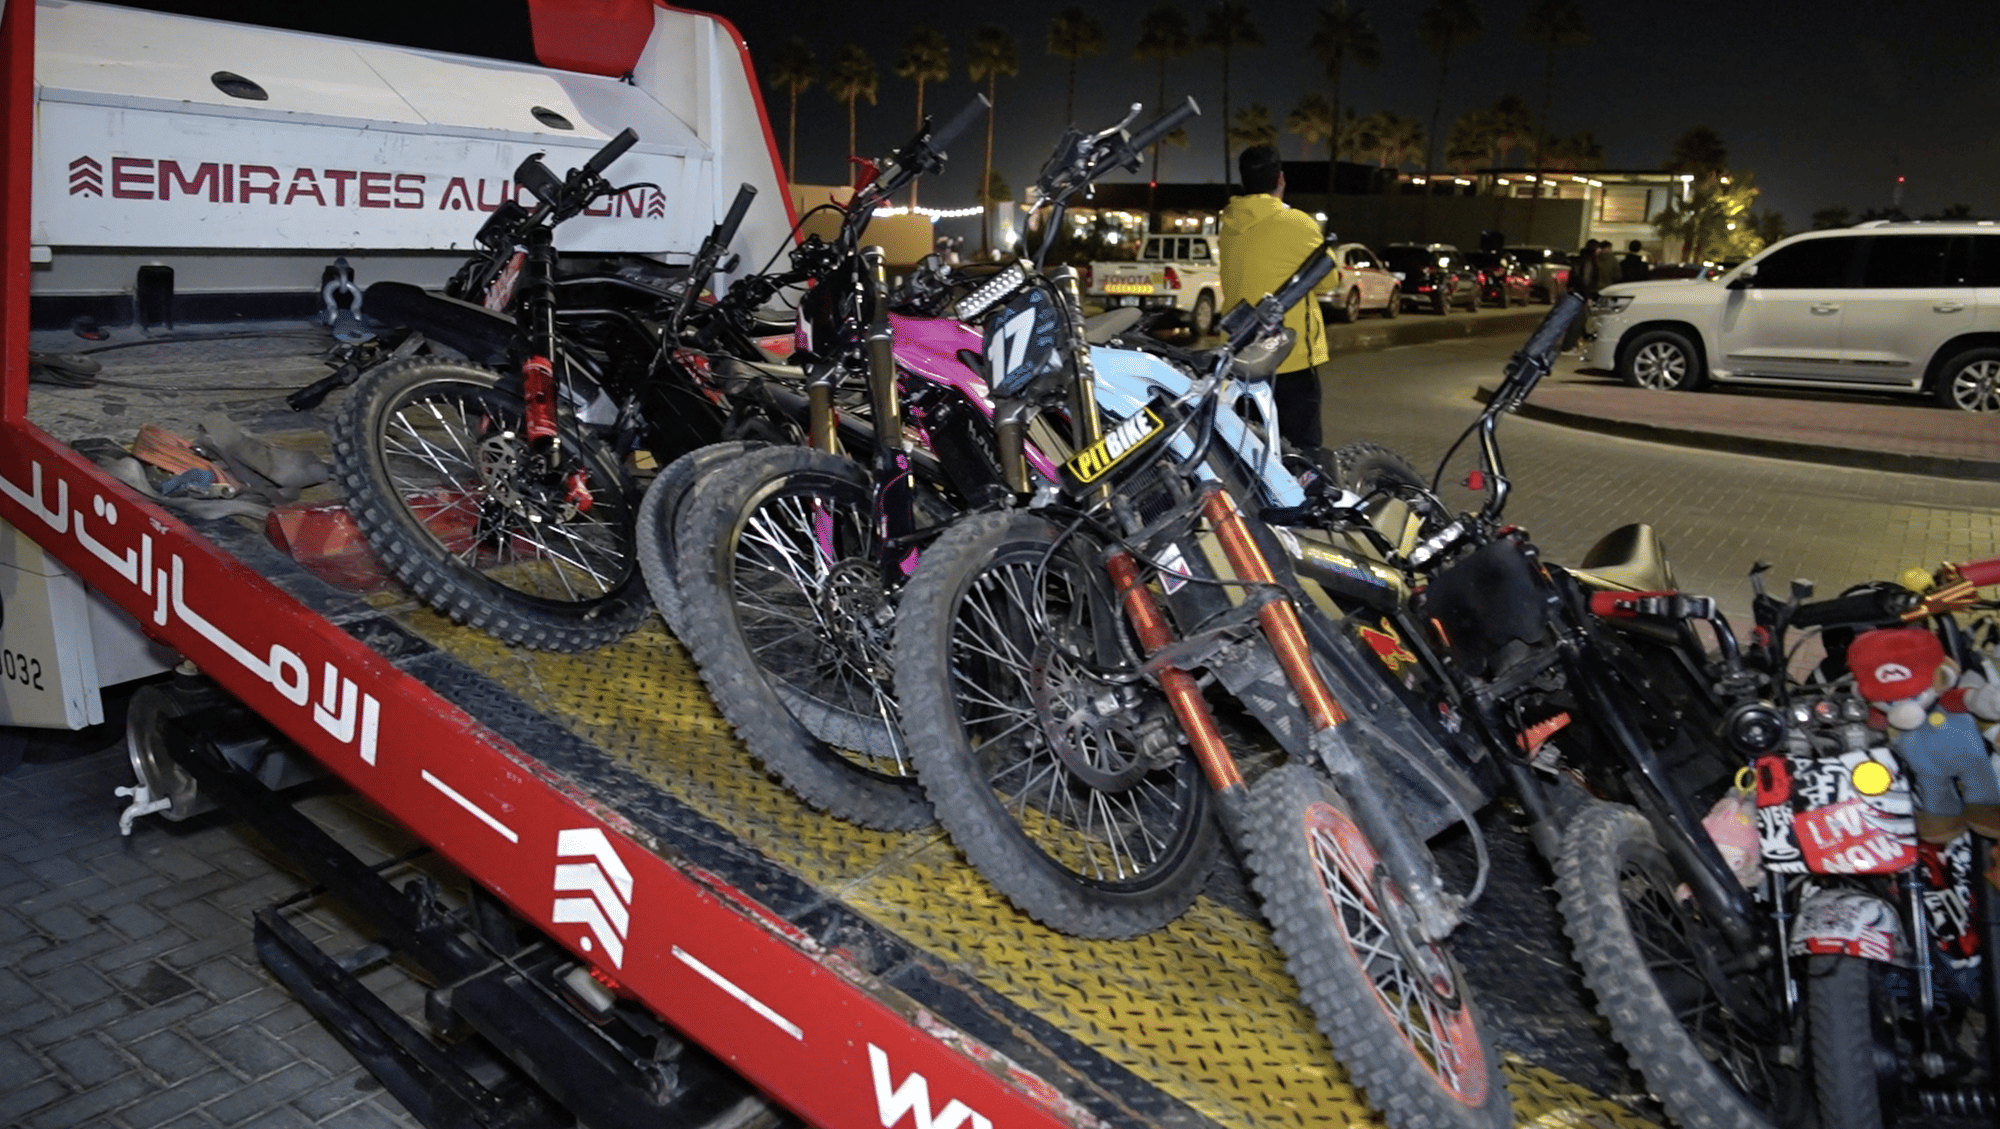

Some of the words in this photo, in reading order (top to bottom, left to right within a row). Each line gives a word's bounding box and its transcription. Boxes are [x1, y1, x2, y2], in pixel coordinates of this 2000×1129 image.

[111, 156, 427, 210] EMIRATES
[438, 176, 645, 219] AUCON
[1103, 274, 1153, 285] TOYOTA
[987, 306, 1036, 390] 17
[1076, 409, 1153, 479] PITBIKE
[0, 649, 44, 691] 032
